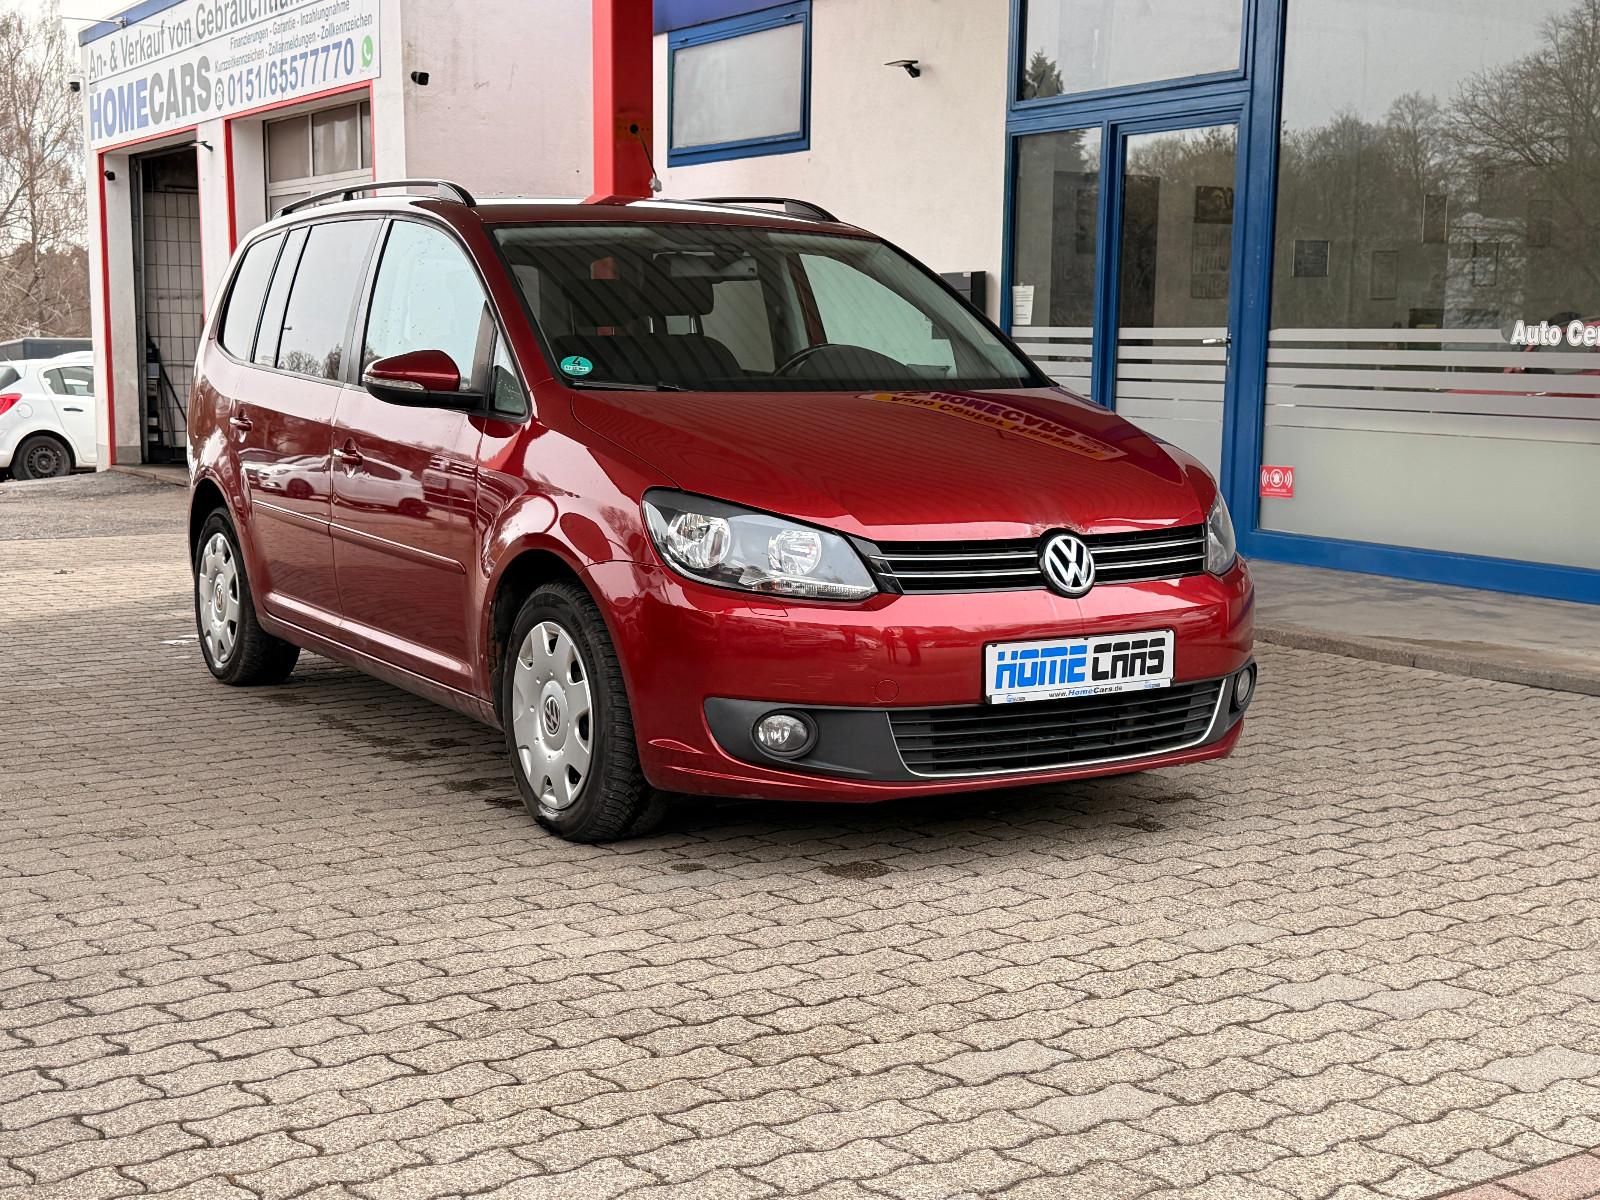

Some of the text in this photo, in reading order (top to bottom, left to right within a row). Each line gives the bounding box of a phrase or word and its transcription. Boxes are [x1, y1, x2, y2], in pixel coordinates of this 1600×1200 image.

[109, 40, 118, 72] &
[120, 19, 165, 67] Verkauf
[168, 18, 192, 50] von
[228, 37, 354, 106] 0151/65577770
[89, 56, 211, 140] HOMECARS
[1510, 320, 1562, 346] Auto
[572, 356, 581, 366] 4
[995, 638, 1166, 689] HOME CARS
[1048, 685, 1123, 698] www.HomeCars.de
